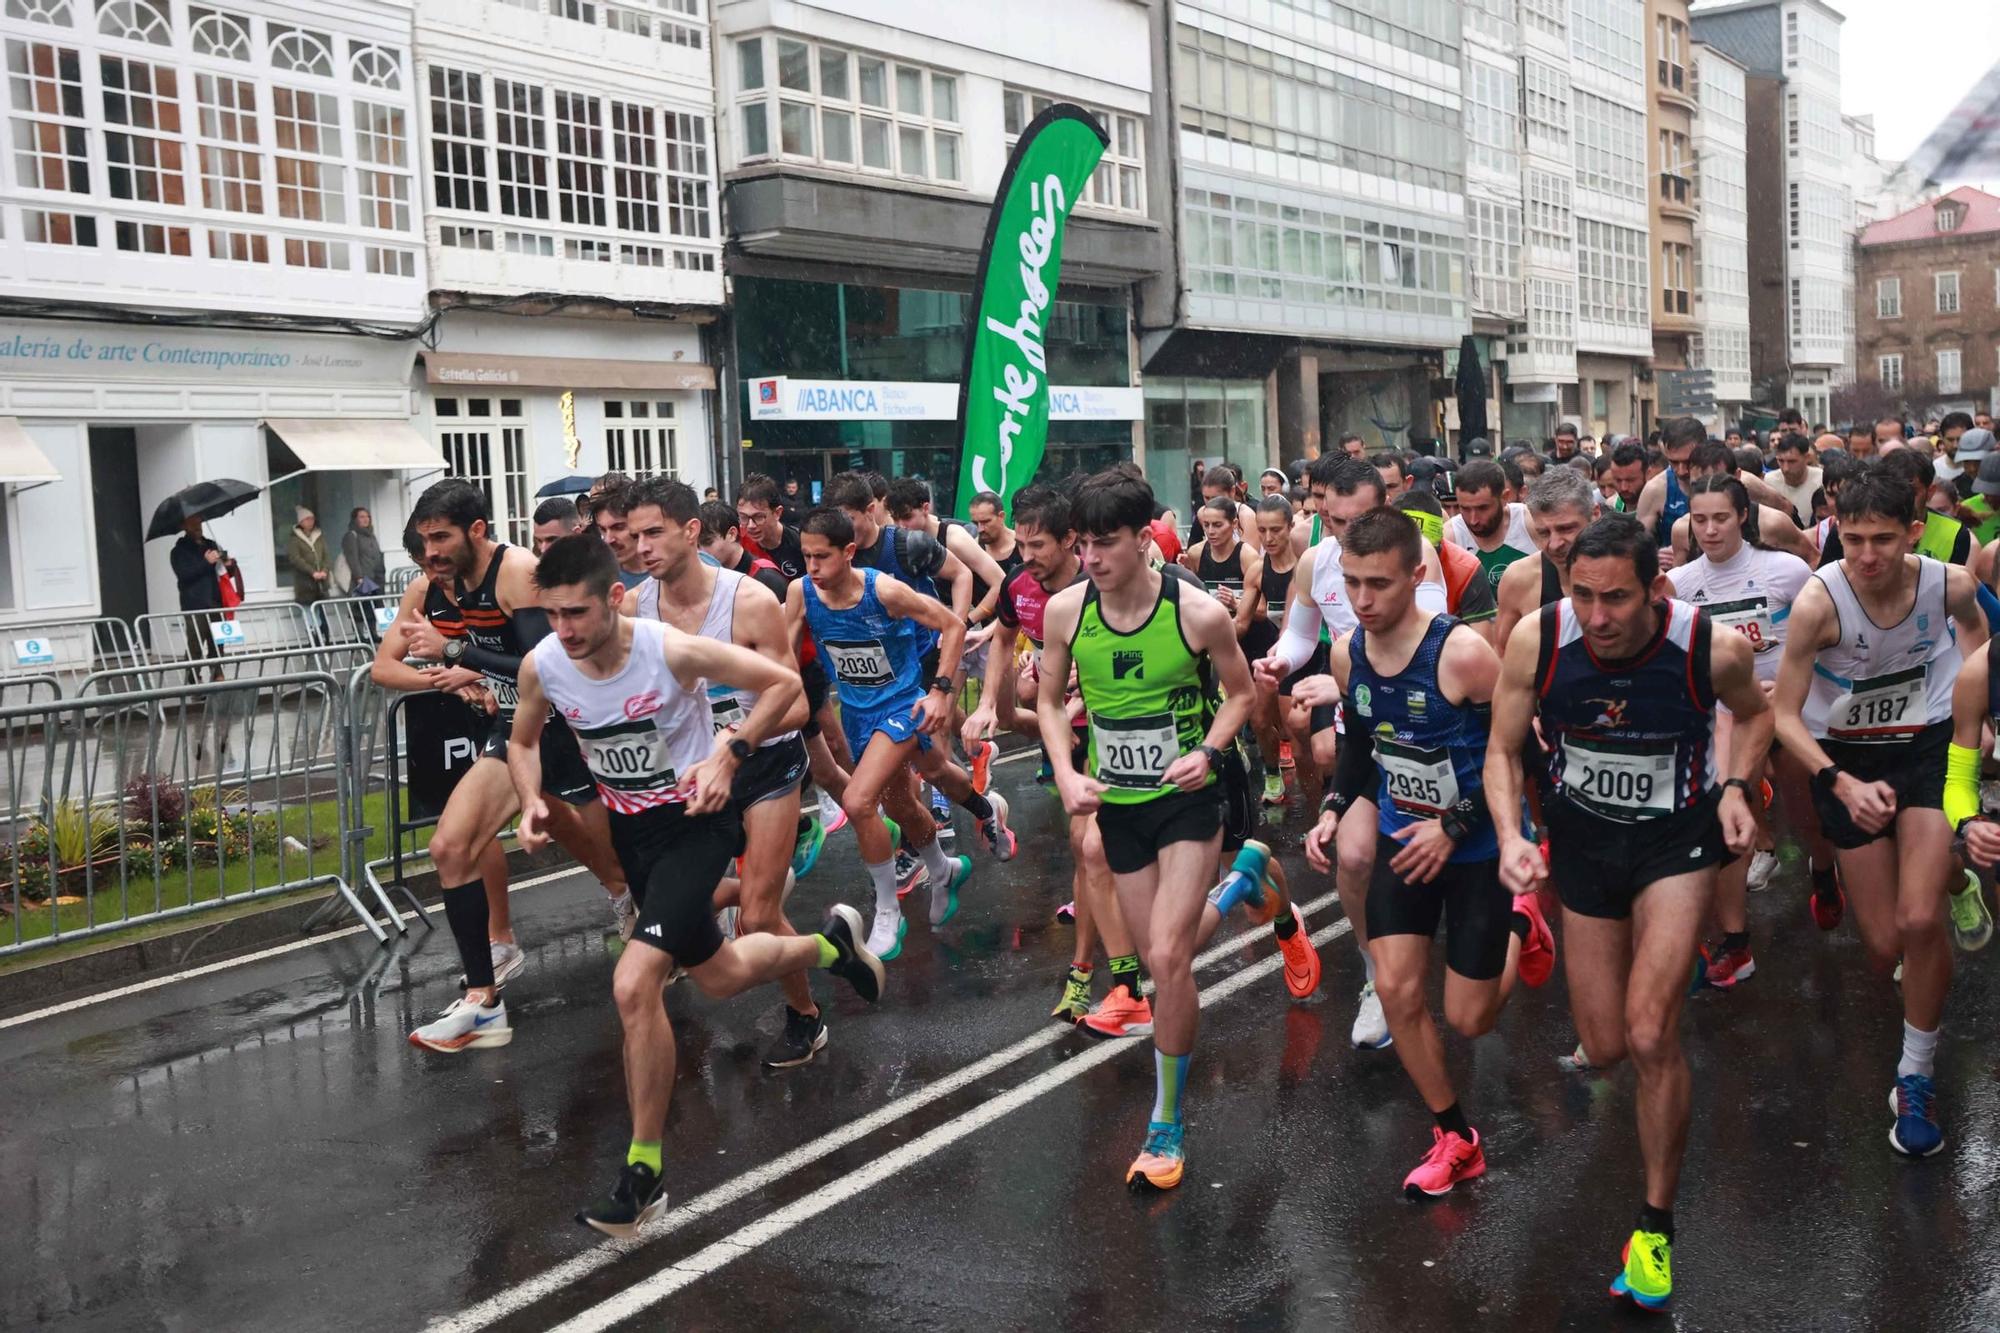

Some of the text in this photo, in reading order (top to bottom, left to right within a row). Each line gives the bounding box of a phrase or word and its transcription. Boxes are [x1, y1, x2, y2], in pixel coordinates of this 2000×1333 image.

[67, 338, 93, 360] de
[98, 344, 137, 361] arte
[143, 342, 290, 370] Contemporáneo
[1050, 393, 1081, 413] NCA
[838, 656, 879, 675] 2030
[1846, 695, 1909, 726] 3187
[593, 745, 655, 774] 2002
[1106, 744, 1166, 771] 2012
[1386, 770, 1442, 805] 2935
[1579, 765, 1653, 803] 2009
